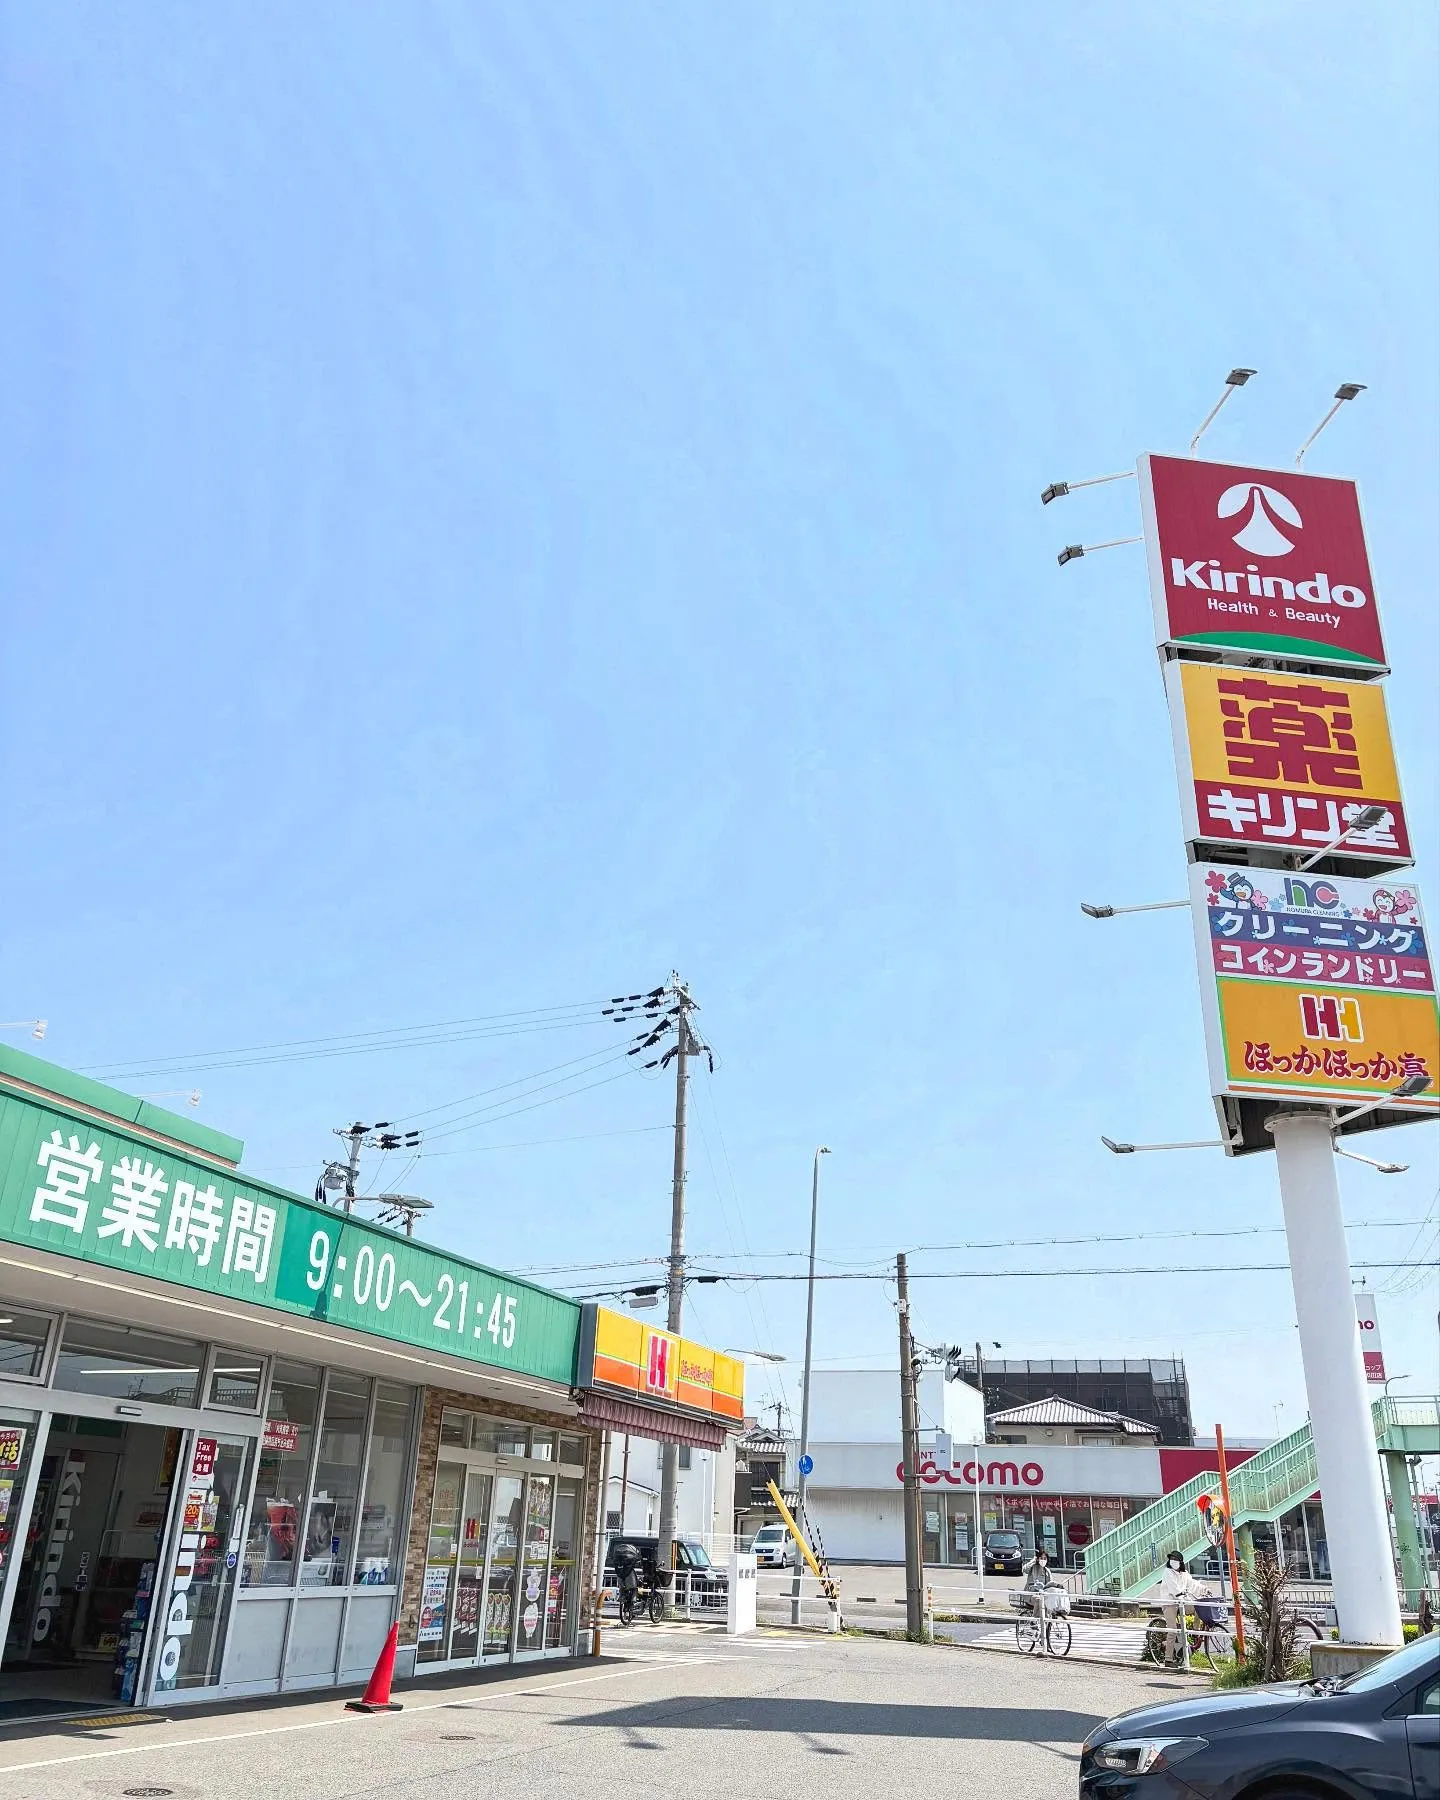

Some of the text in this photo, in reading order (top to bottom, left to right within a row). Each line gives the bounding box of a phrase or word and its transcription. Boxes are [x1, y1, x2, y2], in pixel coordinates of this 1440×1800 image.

[1171, 557, 1367, 609] Kirindo
[1207, 597, 1341, 629] Health & Beauty
[1218, 911, 1416, 954] クリーニング
[1220, 944, 1426, 984] コインランドリー
[28, 1129, 277, 1284] 営業時間
[196, 1452, 212, 1462] Free
[198, 1441, 211, 1452] Tax
